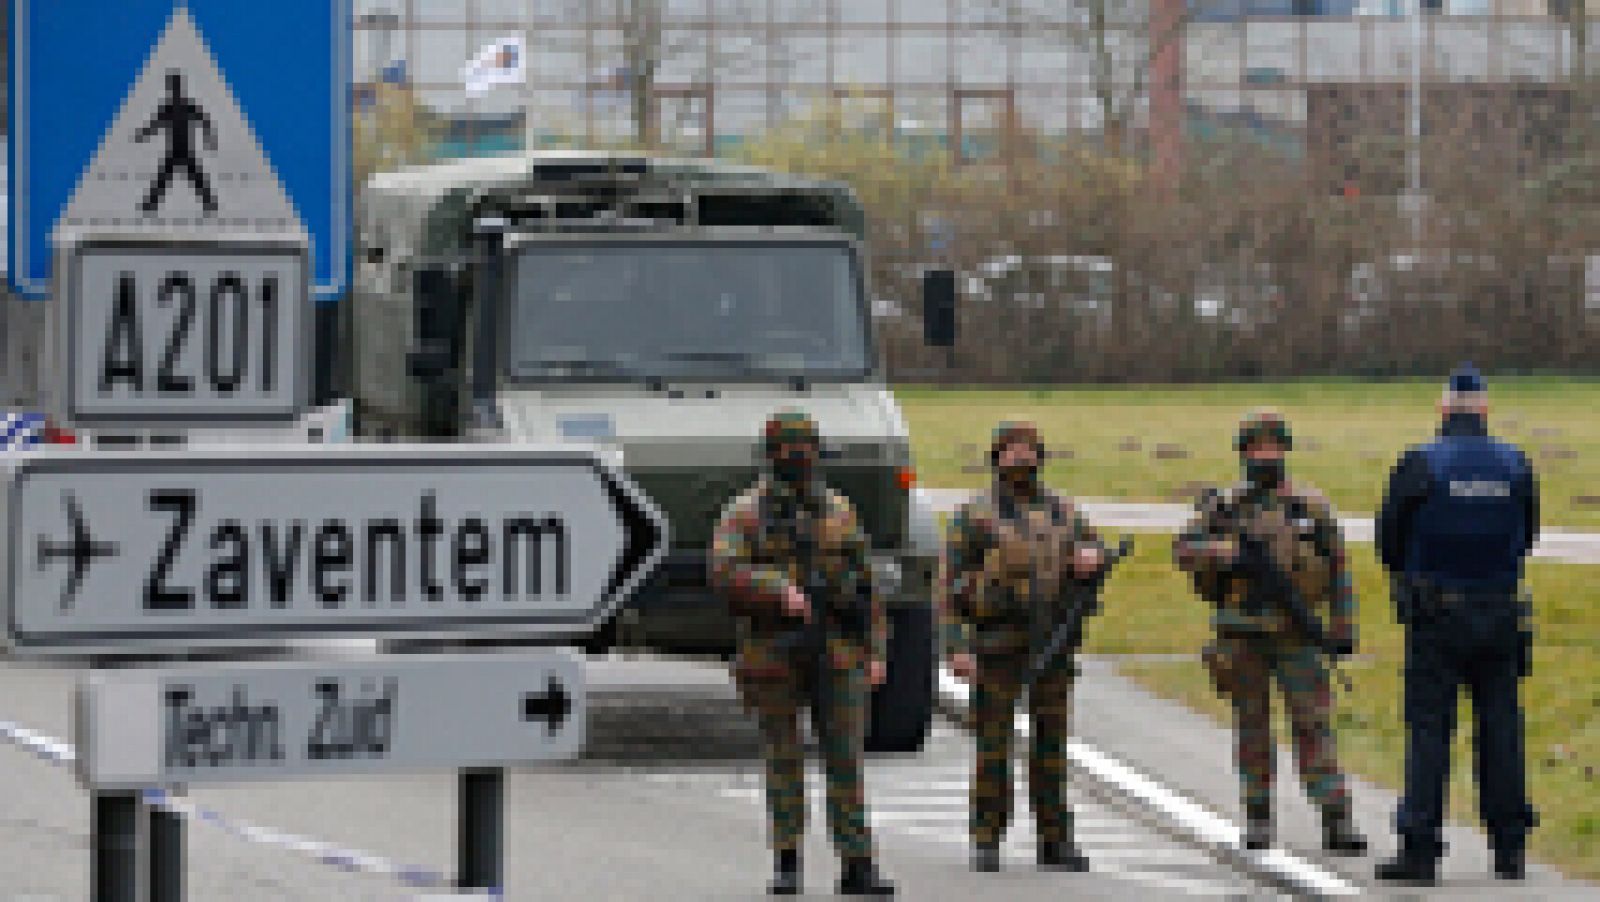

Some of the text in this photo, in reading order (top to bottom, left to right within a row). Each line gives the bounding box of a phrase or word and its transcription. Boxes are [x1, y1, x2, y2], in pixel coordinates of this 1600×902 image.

[101, 271, 278, 393] A201
[144, 489, 570, 610] Zaventem
[307, 678, 397, 760] Zuid
